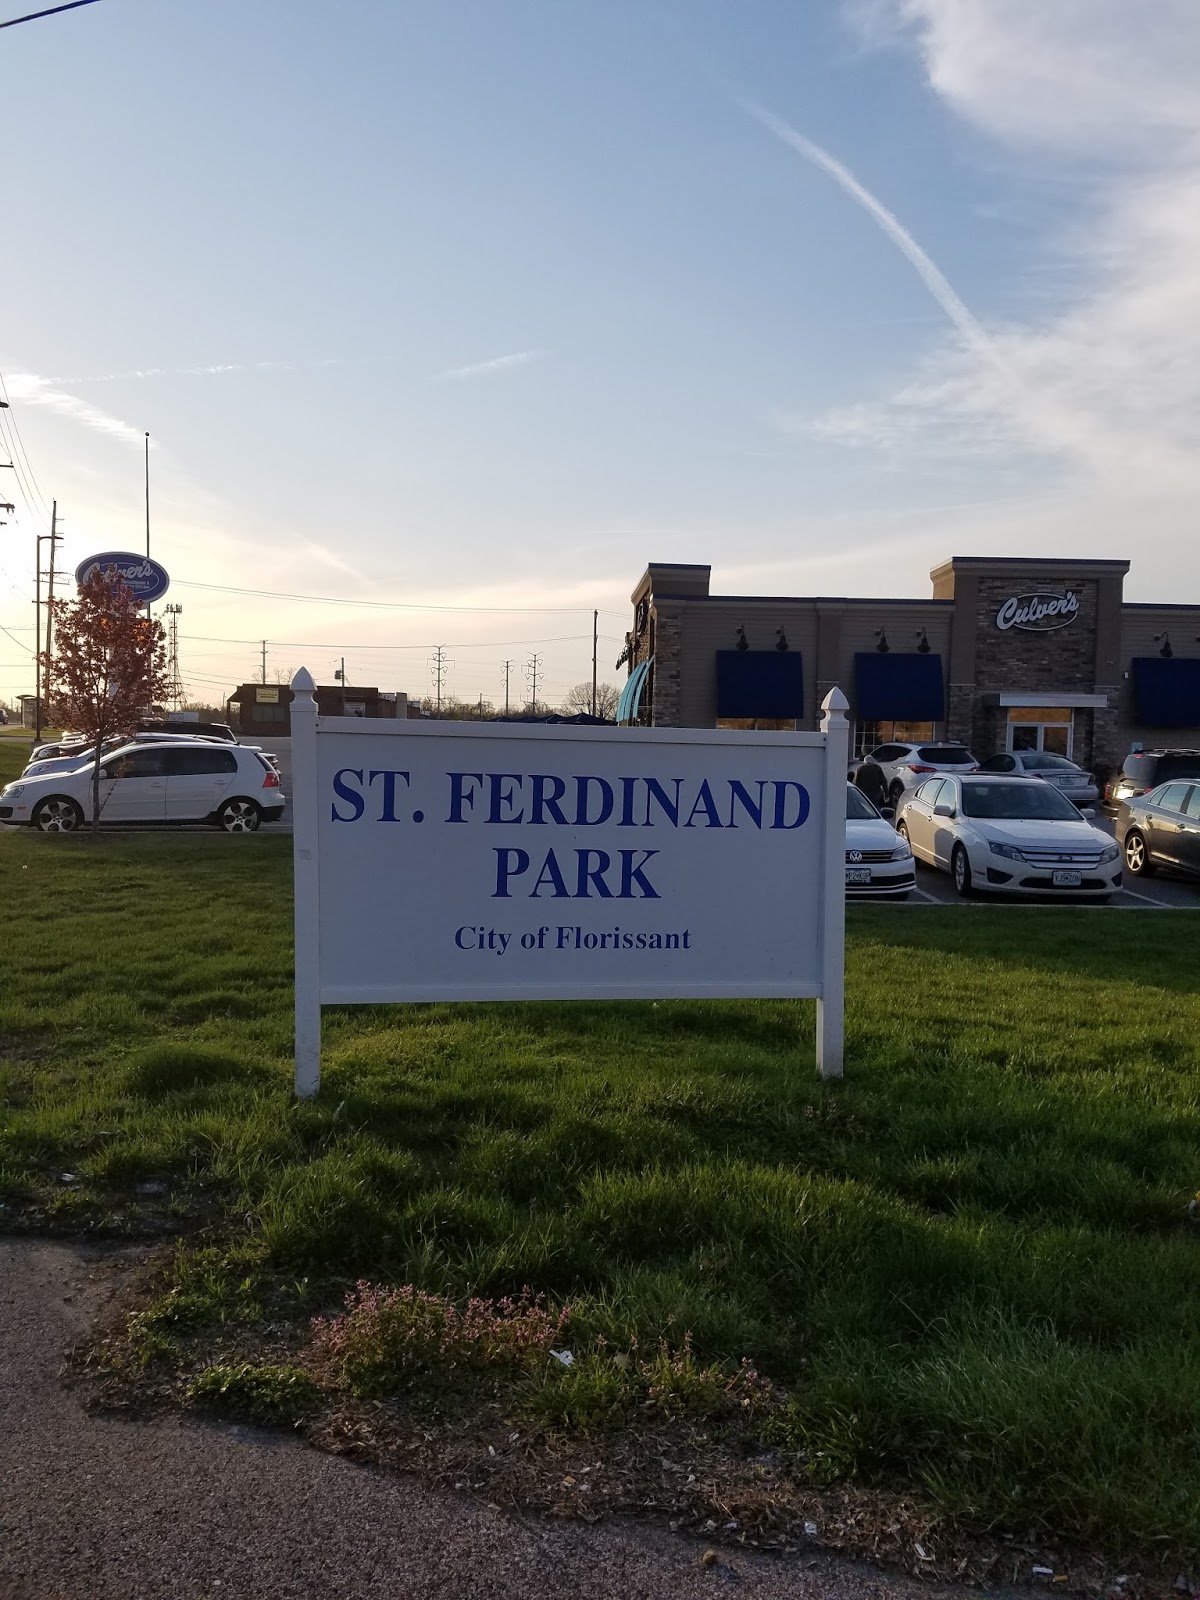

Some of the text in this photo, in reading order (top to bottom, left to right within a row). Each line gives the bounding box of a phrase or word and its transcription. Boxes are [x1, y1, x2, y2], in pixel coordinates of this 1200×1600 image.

[996, 591, 1079, 630] Culver's
[331, 768, 811, 831] ST. FERDINAND
[490, 847, 662, 899] PARK
[454, 925, 692, 956] City of Florissant
